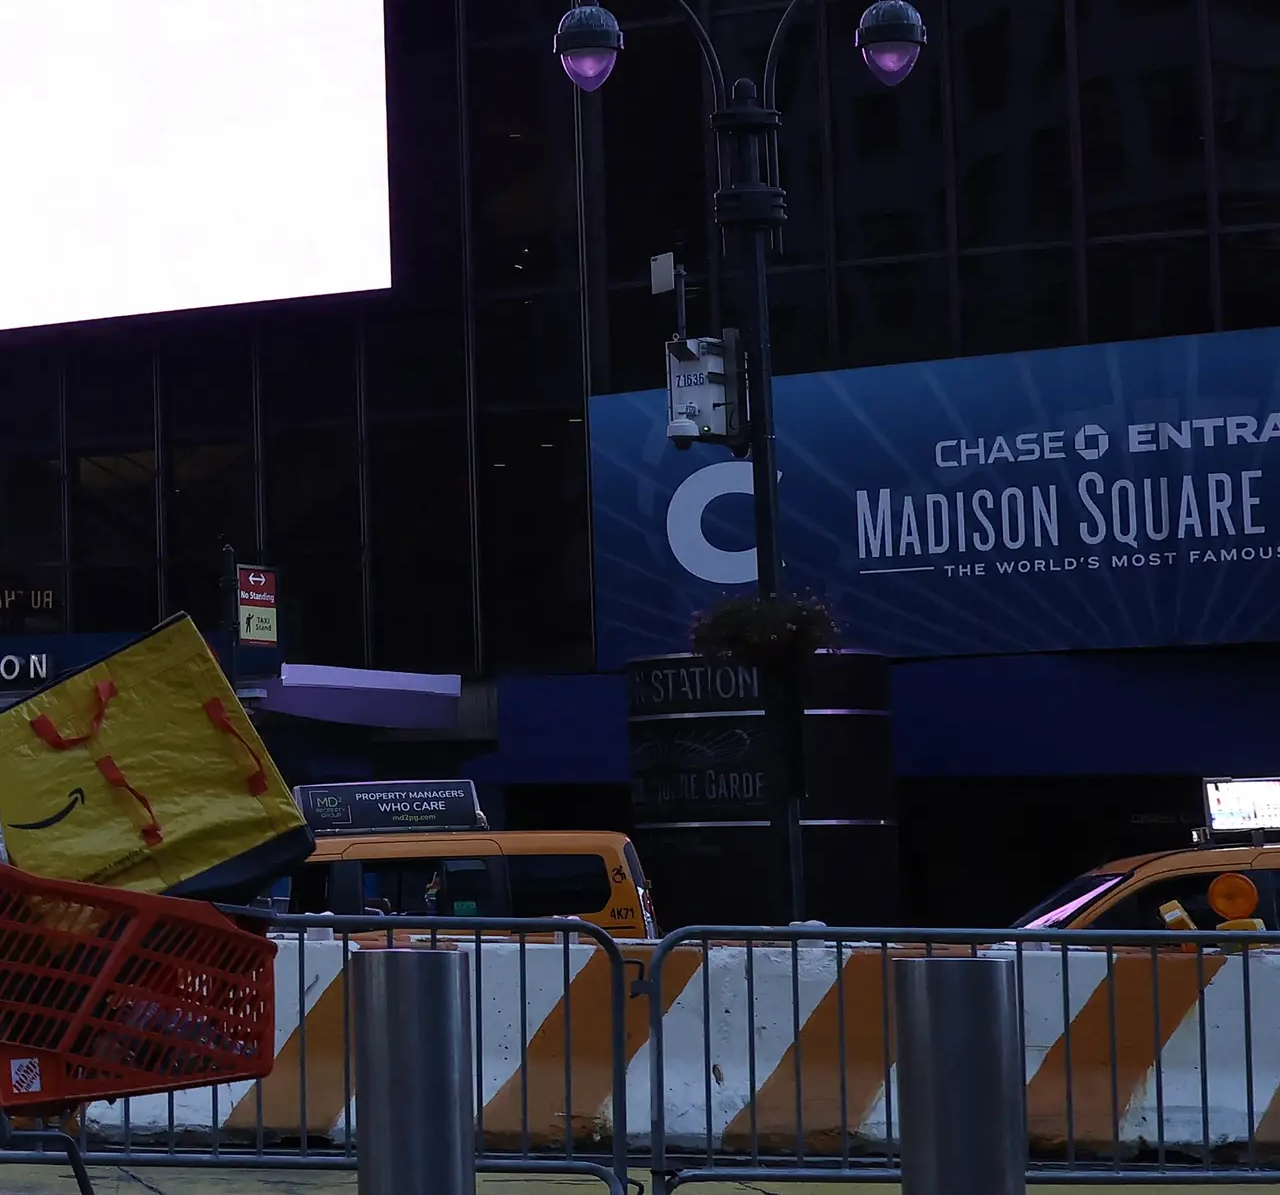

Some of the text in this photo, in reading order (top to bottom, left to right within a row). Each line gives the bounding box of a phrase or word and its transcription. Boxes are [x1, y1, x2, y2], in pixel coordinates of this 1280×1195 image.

[934, 430, 1067, 469] CHASE
[855, 469, 1267, 559] MADISON SQUARE
[943, 544, 1280, 578] THE WORLD'S MOST FAMOU
[240, 590, 275, 604] No Standing
[256, 616, 271, 625] TAXI
[255, 623, 272, 632] Stand
[651, 664, 760, 703] STATION
[355, 789, 465, 801] PROPERTY MANAGERS
[377, 800, 447, 813] WHO CARE
[392, 813, 436, 822] md2pg.com
[609, 907, 635, 919] 4K71
